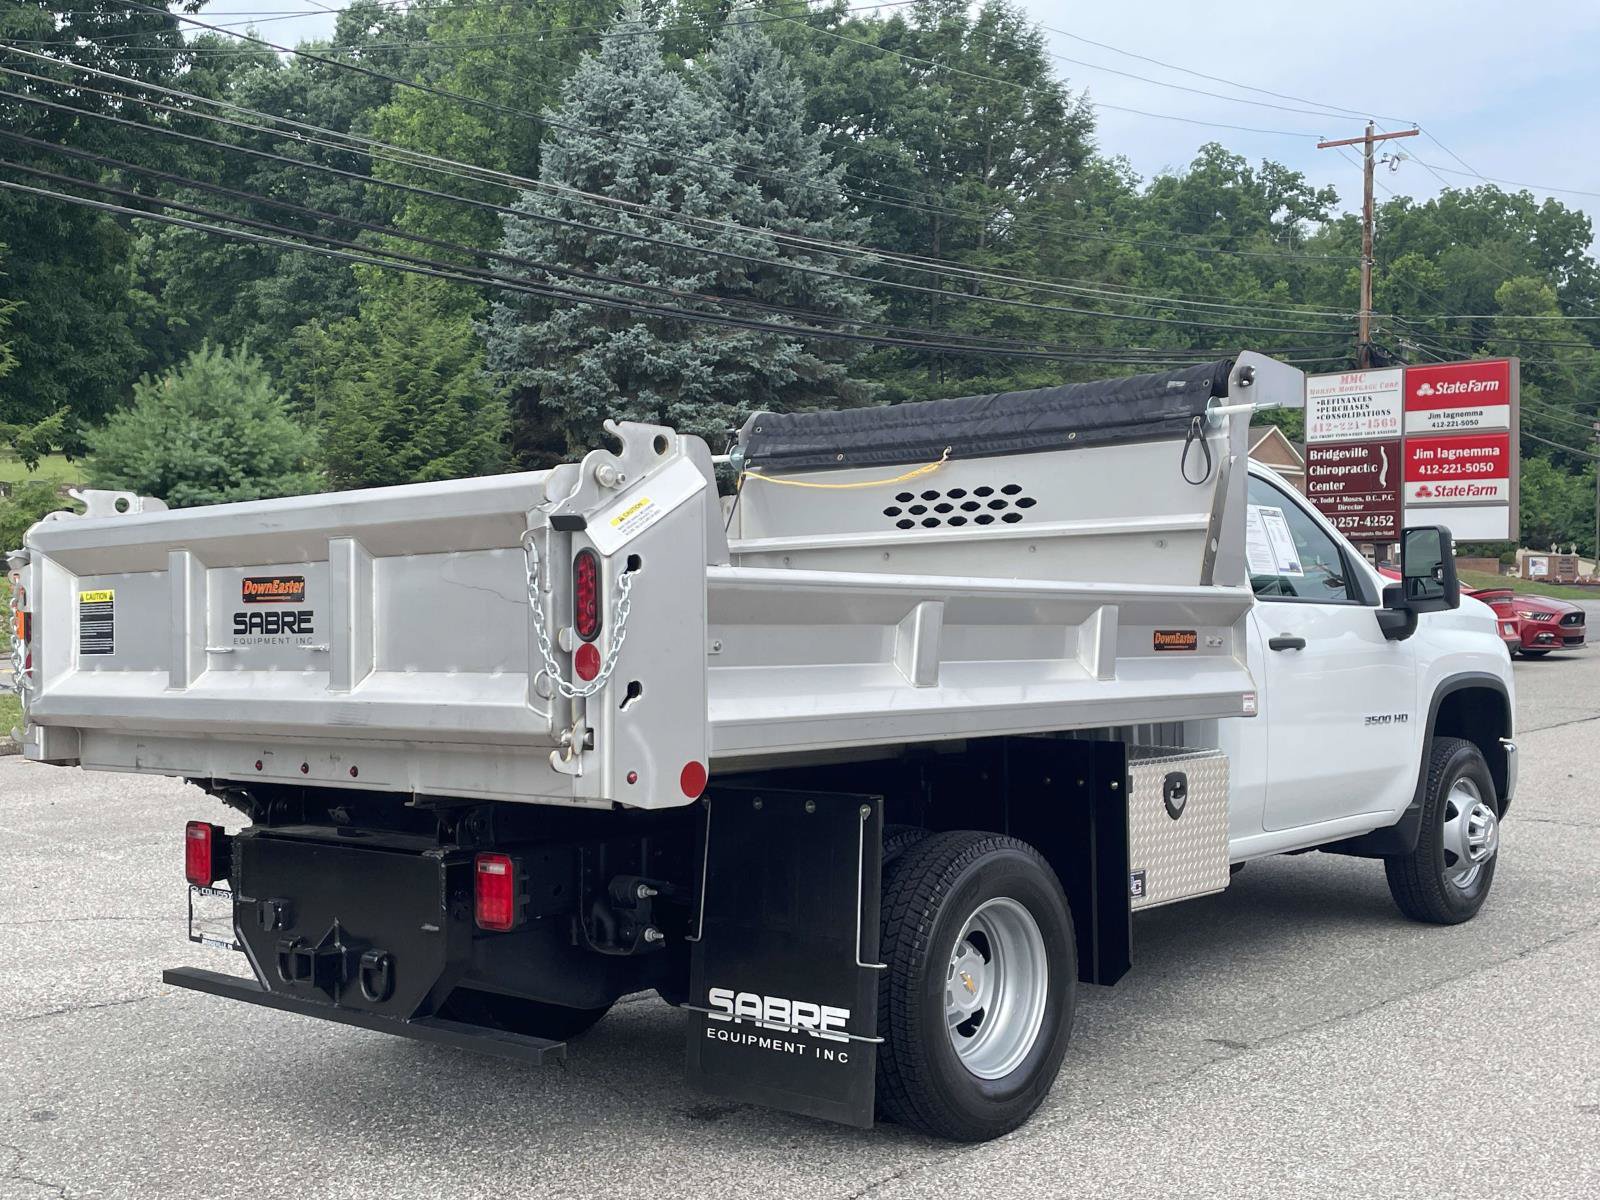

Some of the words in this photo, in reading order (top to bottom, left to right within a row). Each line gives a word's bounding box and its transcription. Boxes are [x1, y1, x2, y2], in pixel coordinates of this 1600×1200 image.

[1340, 373, 1366, 384] MMC
[1320, 395, 1373, 406] REFINANCES
[1320, 403, 1370, 413] PURCHASES
[1320, 408, 1392, 421] CONSOLIDATIONS
[1428, 412, 1441, 420] Jim
[1431, 419, 1479, 428] 412-221-5050
[1309, 447, 1369, 461] Bridgeville
[1413, 448, 1433, 460] Jim
[1437, 447, 1500, 460] Iagnemma
[1309, 463, 1378, 476] Chiropractic
[1418, 462, 1494, 475] 412-221-5050
[1309, 481, 1346, 491] Center
[243, 579, 304, 594] DownEaster
[85, 592, 108, 601] CAUTION
[233, 610, 314, 635] SABRE
[233, 637, 290, 645] EQUIPMENT
[295, 636, 313, 645] INC
[1155, 632, 1197, 644] DownEaster
[1364, 714, 1392, 726] 3500
[1394, 713, 1409, 723] HD
[708, 987, 850, 1043] SABRE
[707, 1027, 806, 1055] EQUIPMENT
[816, 1047, 848, 1064] INC
